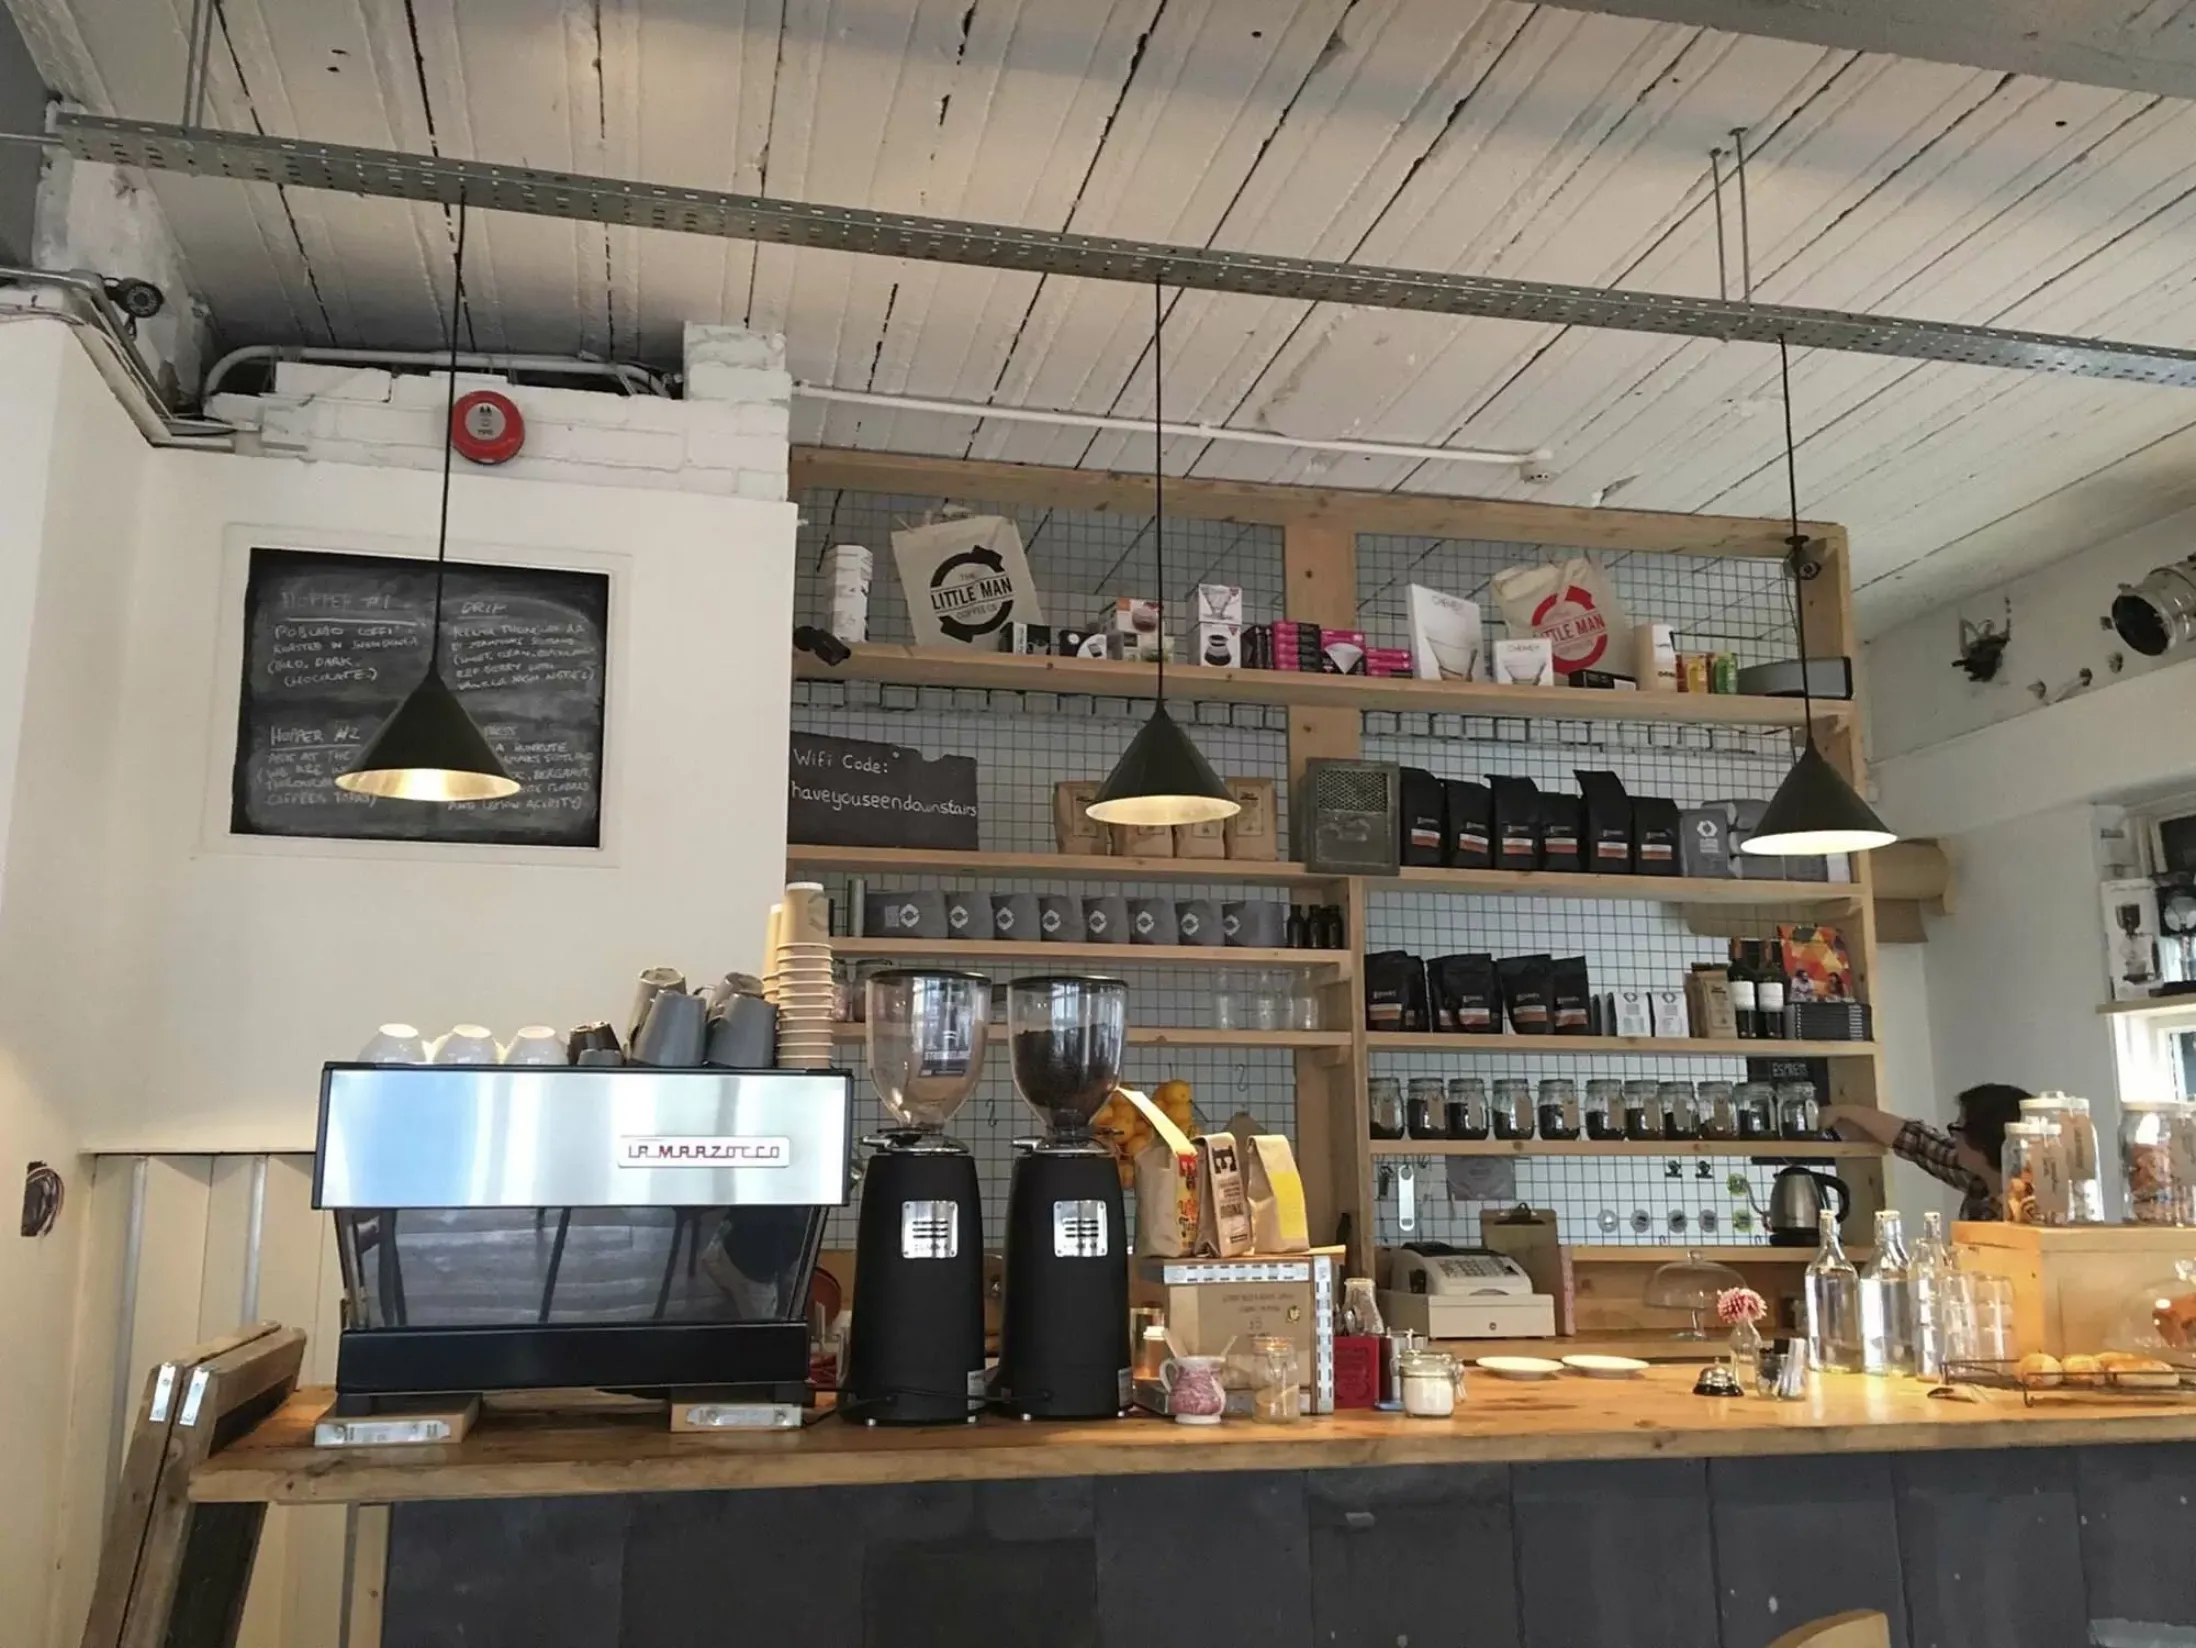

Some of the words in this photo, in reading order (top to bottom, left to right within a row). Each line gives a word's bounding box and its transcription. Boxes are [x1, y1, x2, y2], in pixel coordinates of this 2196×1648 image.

[930, 586, 977, 610] LITTLE
[980, 577, 1012, 598] MAN
[1575, 614, 1605, 635] MAN
[271, 726, 325, 746] HOPPER
[842, 753, 889, 774] Code:
[790, 780, 978, 818] haveyouseendownstairs
[628, 1145, 648, 1158] LA
[658, 1145, 780, 1158] MARZOCCO
